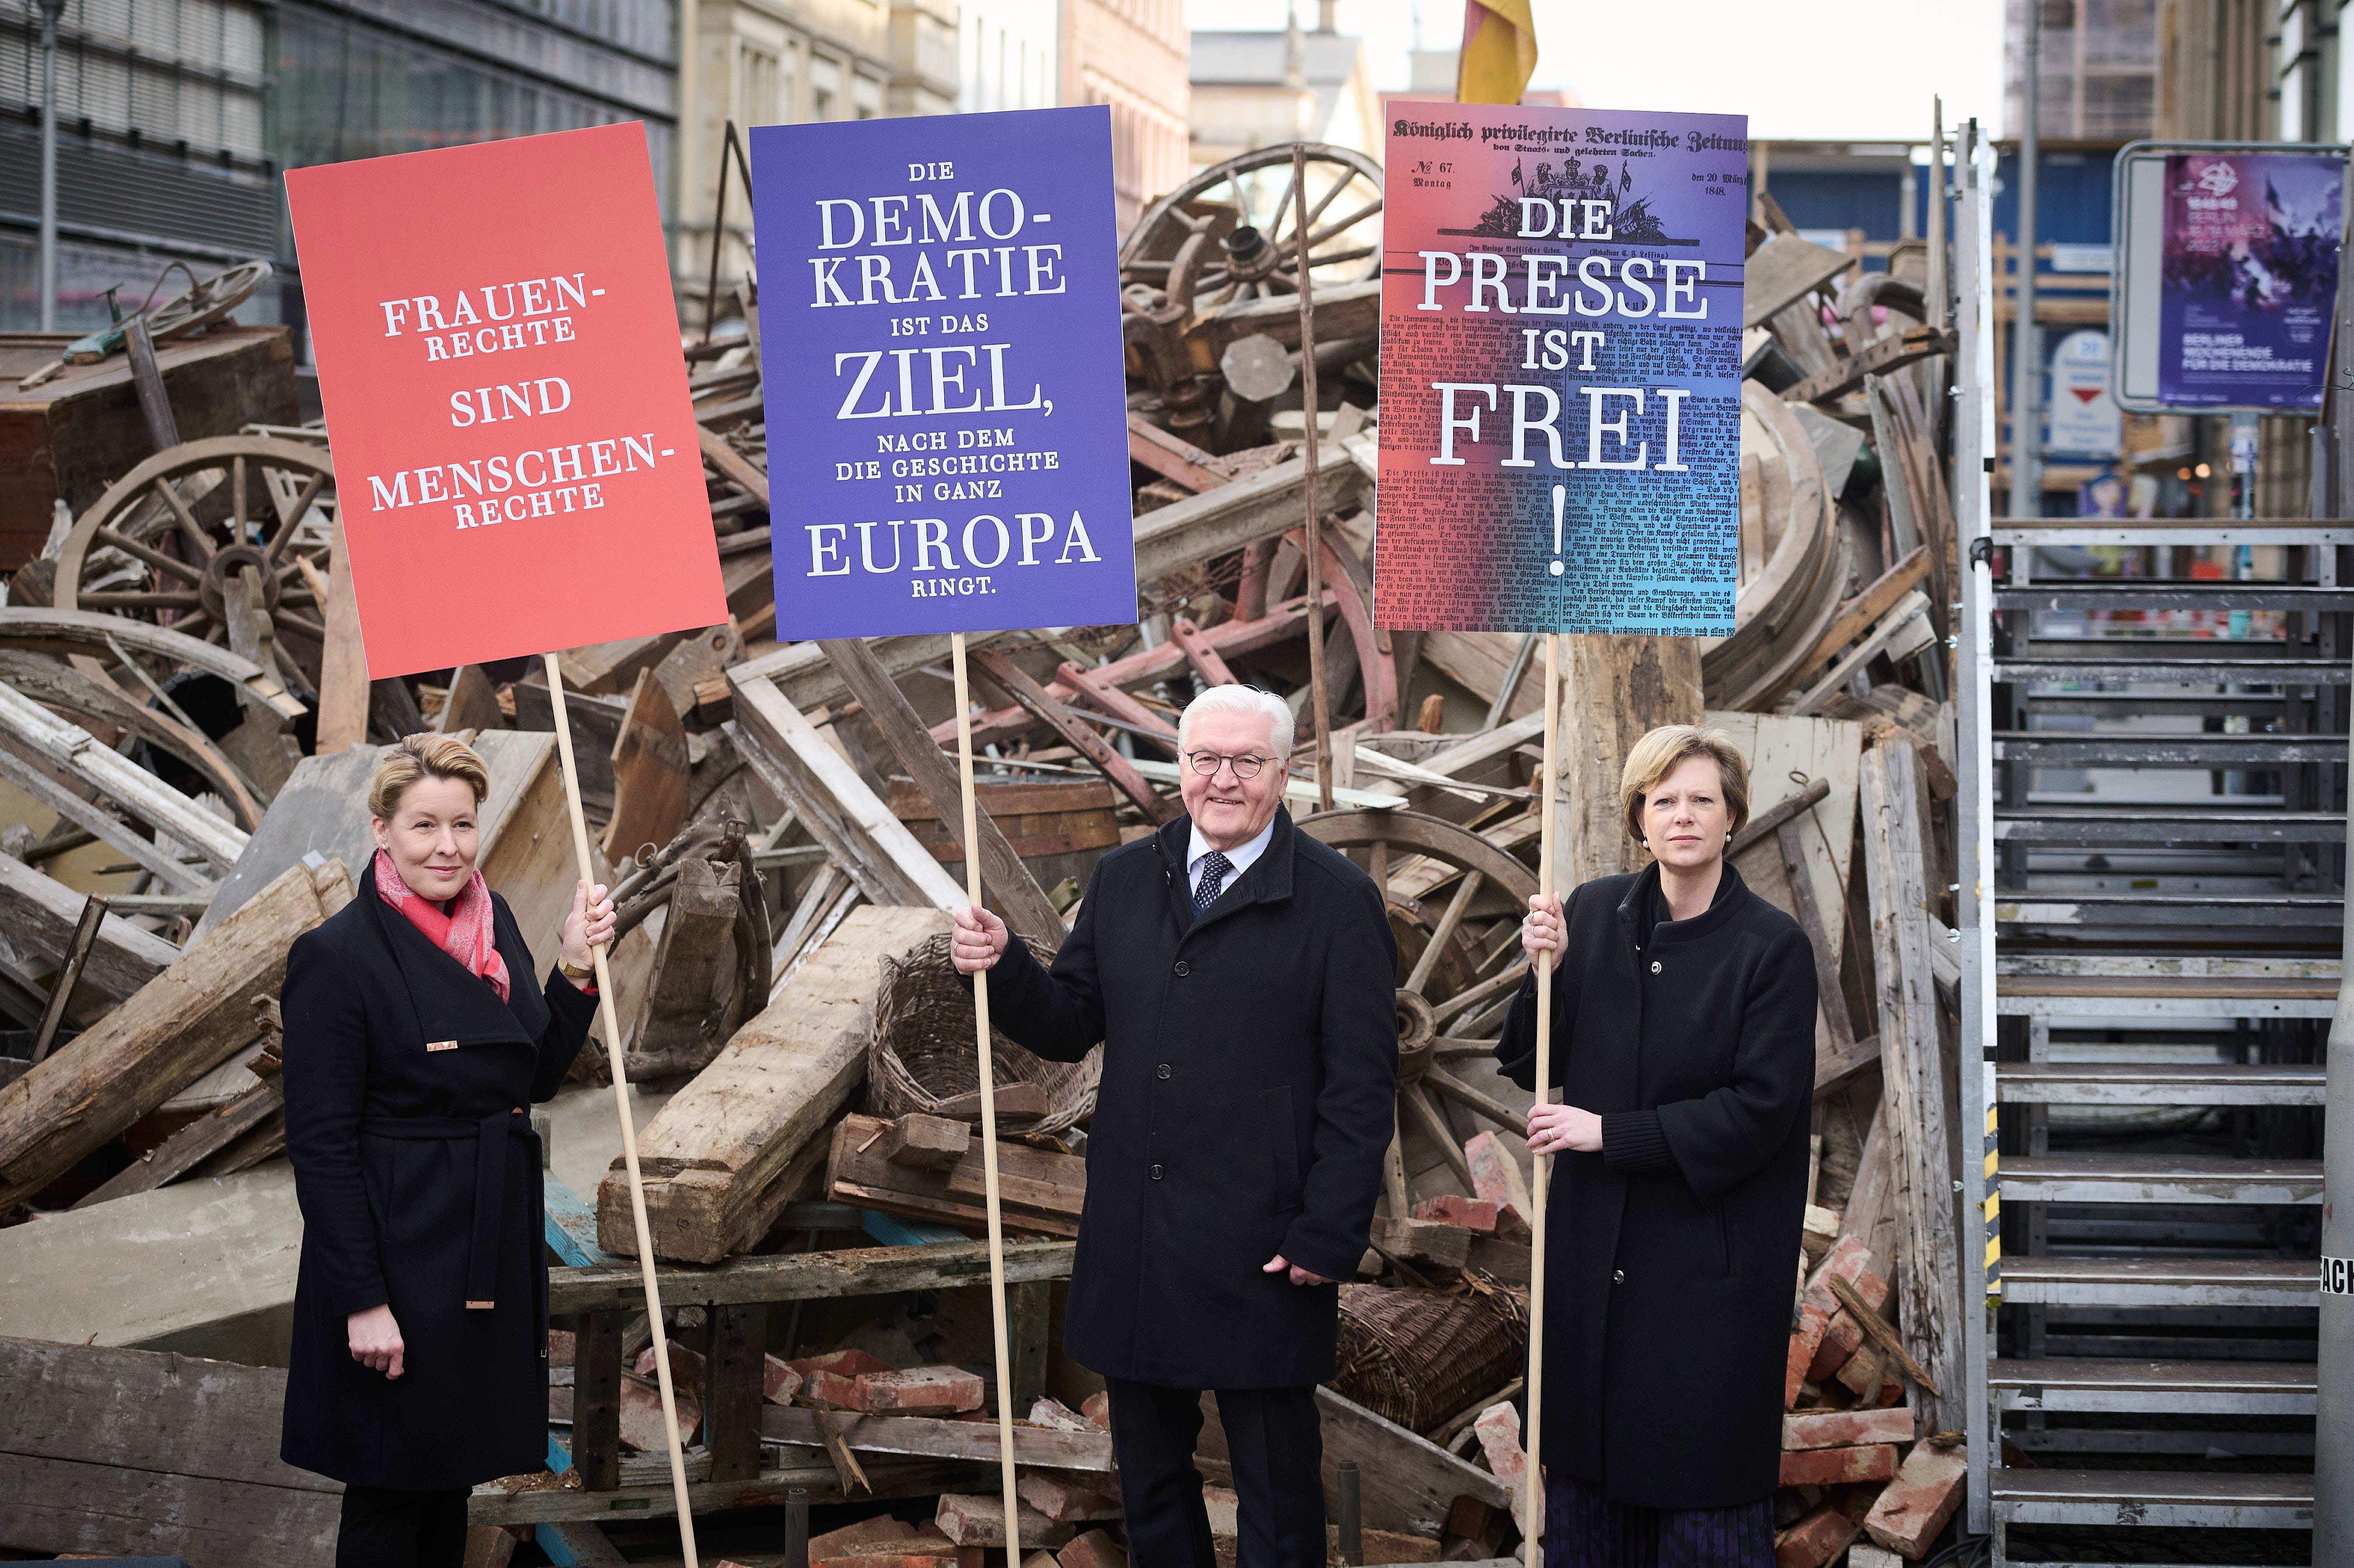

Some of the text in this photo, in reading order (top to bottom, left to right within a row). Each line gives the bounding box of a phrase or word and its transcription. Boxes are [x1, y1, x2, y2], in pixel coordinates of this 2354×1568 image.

[1392, 120, 1473, 142] Königlich
[1481, 123, 1578, 144] privilegirte
[1554, 145, 1570, 154] und
[1574, 146, 1617, 158] gelehrten
[908, 162, 953, 181] DIE
[1413, 178, 1451, 190] Montag
[1439, 163, 1455, 174] 67.
[1692, 173, 1704, 181] den
[1707, 173, 1717, 181] 20
[1705, 186, 1726, 196] 1848.
[816, 189, 1051, 249] DEMO-
[1518, 198, 1612, 240] DIE
[808, 245, 1065, 307] KRATIE
[1417, 251, 1707, 319] PRESSE
[380, 273, 605, 336] FRAUEN-
[891, 314, 988, 336] IST DAS
[425, 317, 575, 361] RECHTE
[1522, 329, 1604, 370] IST
[836, 344, 1053, 419] ZIEL,
[2232, 358, 2314, 373] DEMOKRATIE
[451, 378, 571, 427] SIND
[877, 428, 1014, 452] NACH DEM
[1430, 383, 1690, 471] FREI
[367, 433, 675, 511] MENSCHEN-
[836, 452, 1059, 480] DIE GESCHICHTE
[453, 483, 604, 529] RECHTE
[895, 480, 1001, 502] IN GANZ
[805, 511, 1101, 576] EUROPA
[1550, 485, 1566, 575] !
[912, 575, 997, 597] RINGT.
